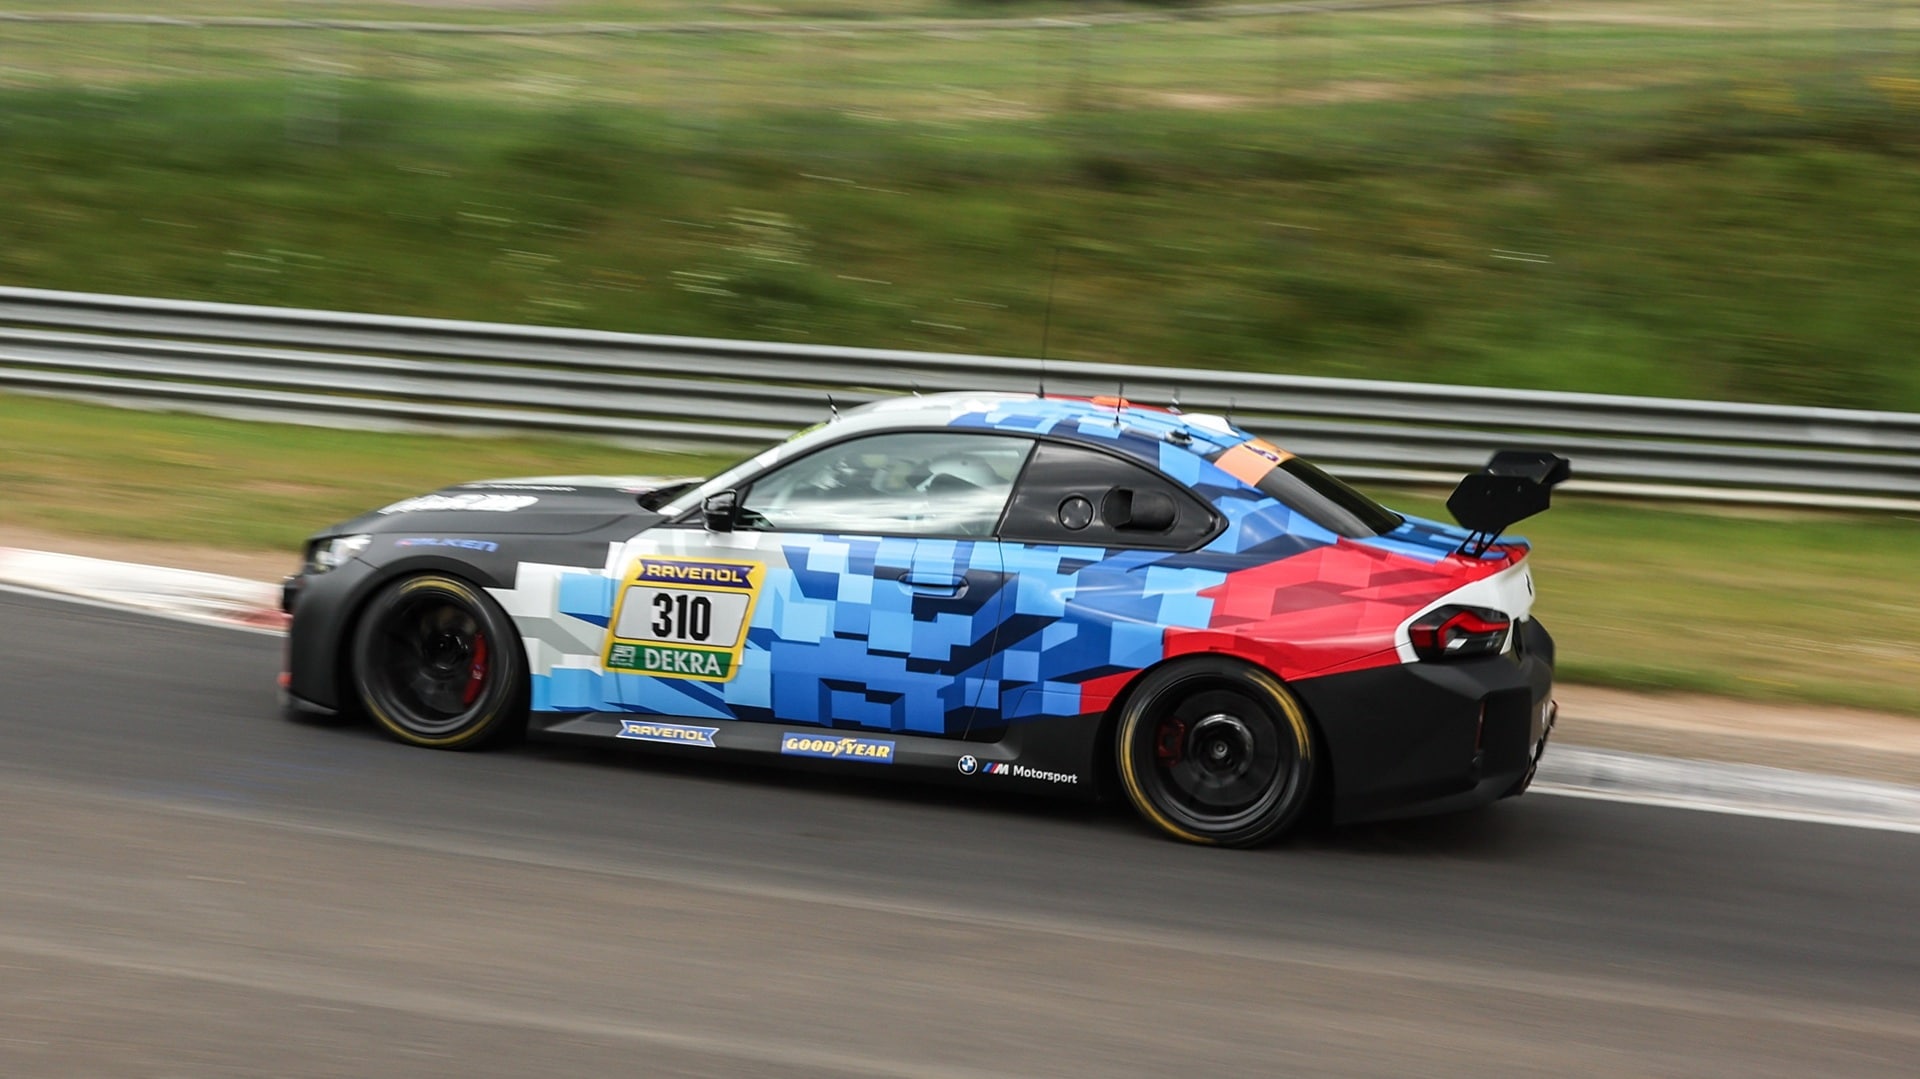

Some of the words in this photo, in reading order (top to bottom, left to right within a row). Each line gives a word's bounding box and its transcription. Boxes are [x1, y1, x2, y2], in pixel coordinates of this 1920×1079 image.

[646, 564, 743, 583] RAVENOL
[652, 593, 711, 641] 310
[644, 648, 722, 675] DEKRA
[627, 724, 706, 741] RAVENOL
[786, 737, 890, 758] GOODYEAR
[1013, 765, 1078, 784] Motorsport
